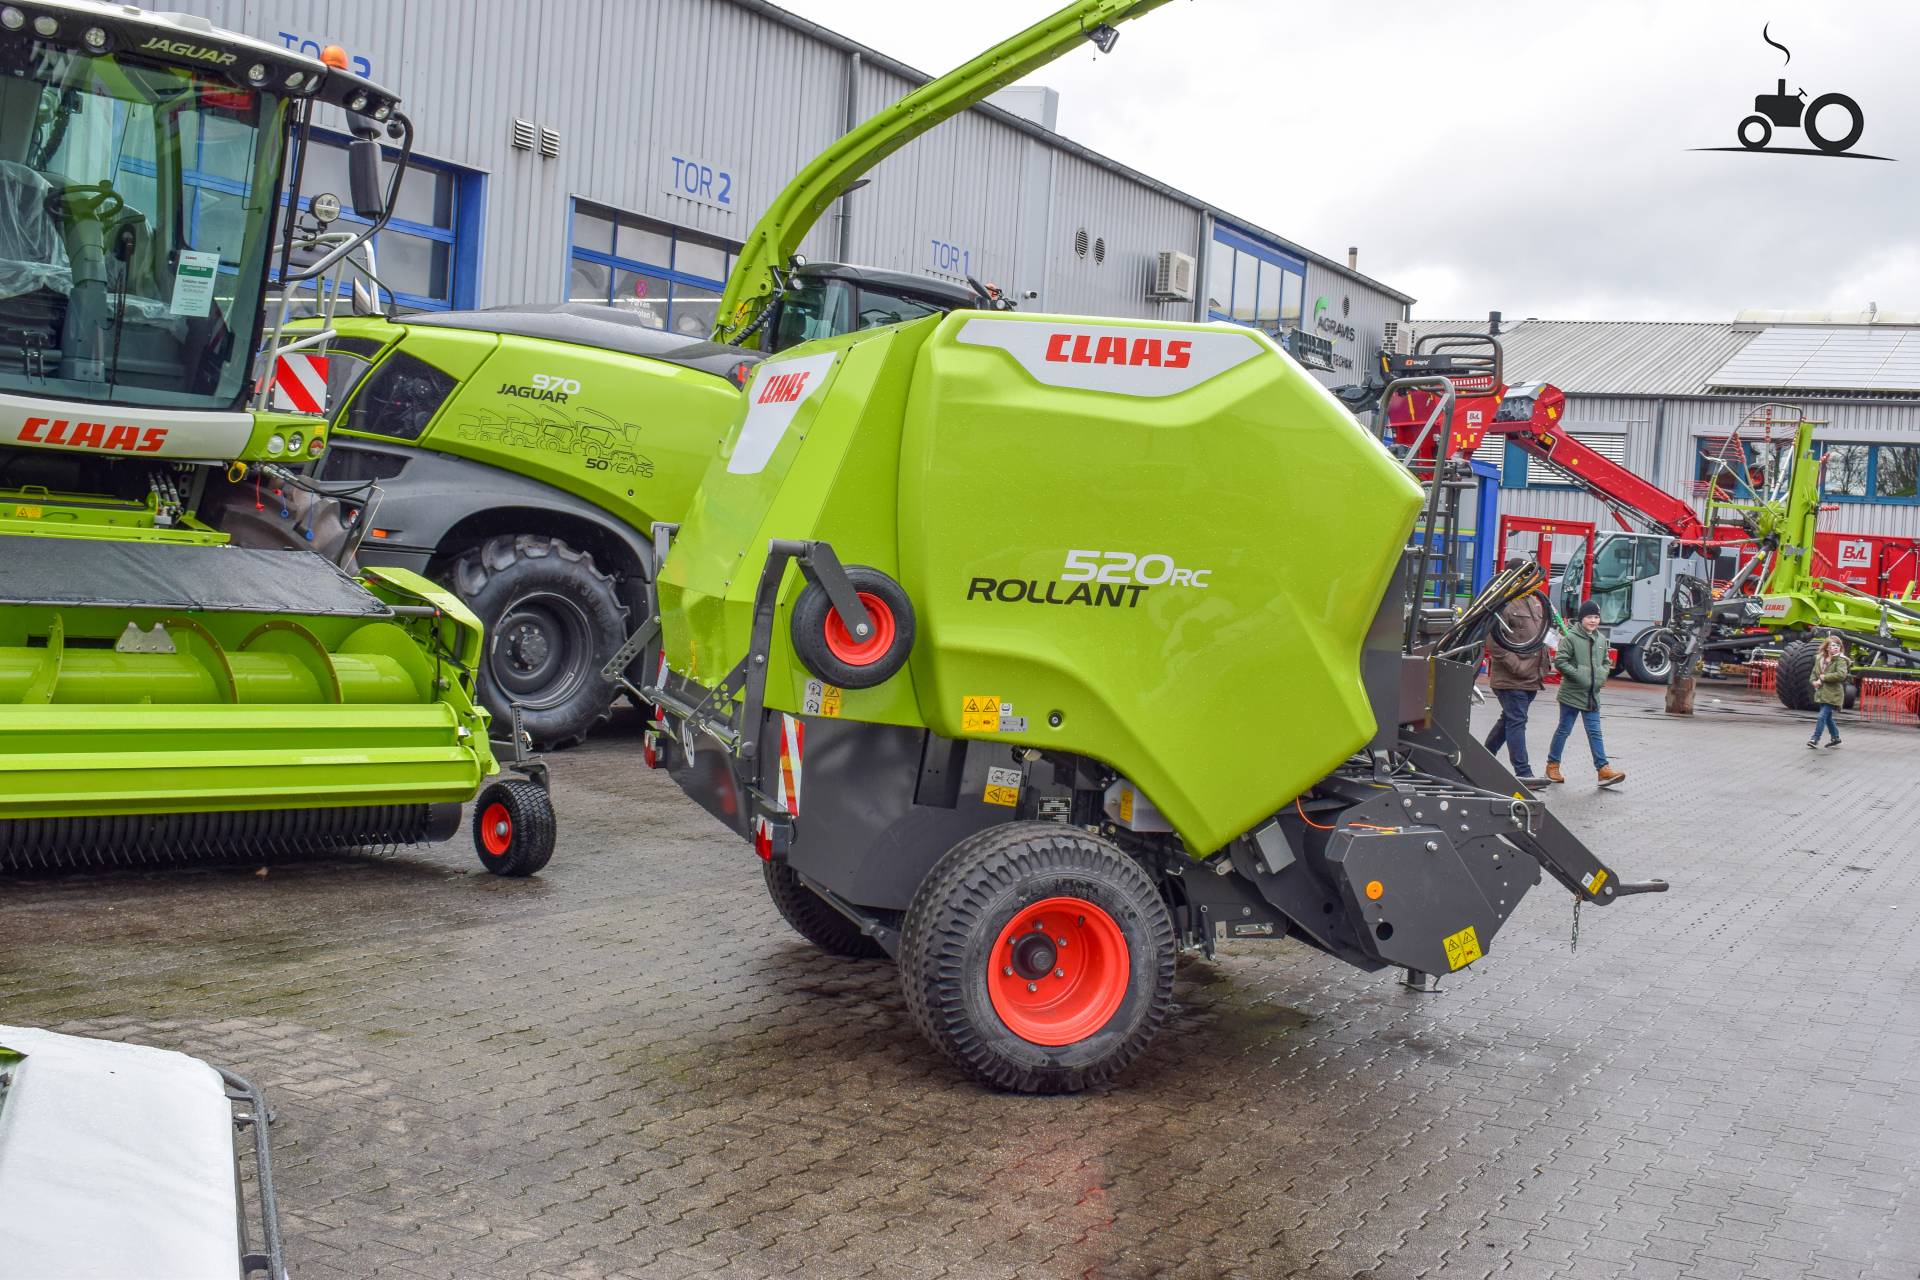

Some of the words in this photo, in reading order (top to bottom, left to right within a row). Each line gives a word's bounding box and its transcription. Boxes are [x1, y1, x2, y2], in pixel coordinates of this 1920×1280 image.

[140, 37, 238, 66] JAGUAR
[671, 156, 712, 199] TOR
[718, 172, 731, 204] 2
[931, 239, 960, 273] TOR
[963, 250, 969, 276] 1
[1317, 315, 1356, 342] AGRAVIS
[1045, 334, 1193, 369] CLAAS
[497, 383, 569, 405] JAGUAR
[531, 374, 582, 396] 970
[756, 371, 811, 405] CLAAS
[16, 416, 169, 452] CLAAS
[967, 577, 1150, 608] ROLLANT
